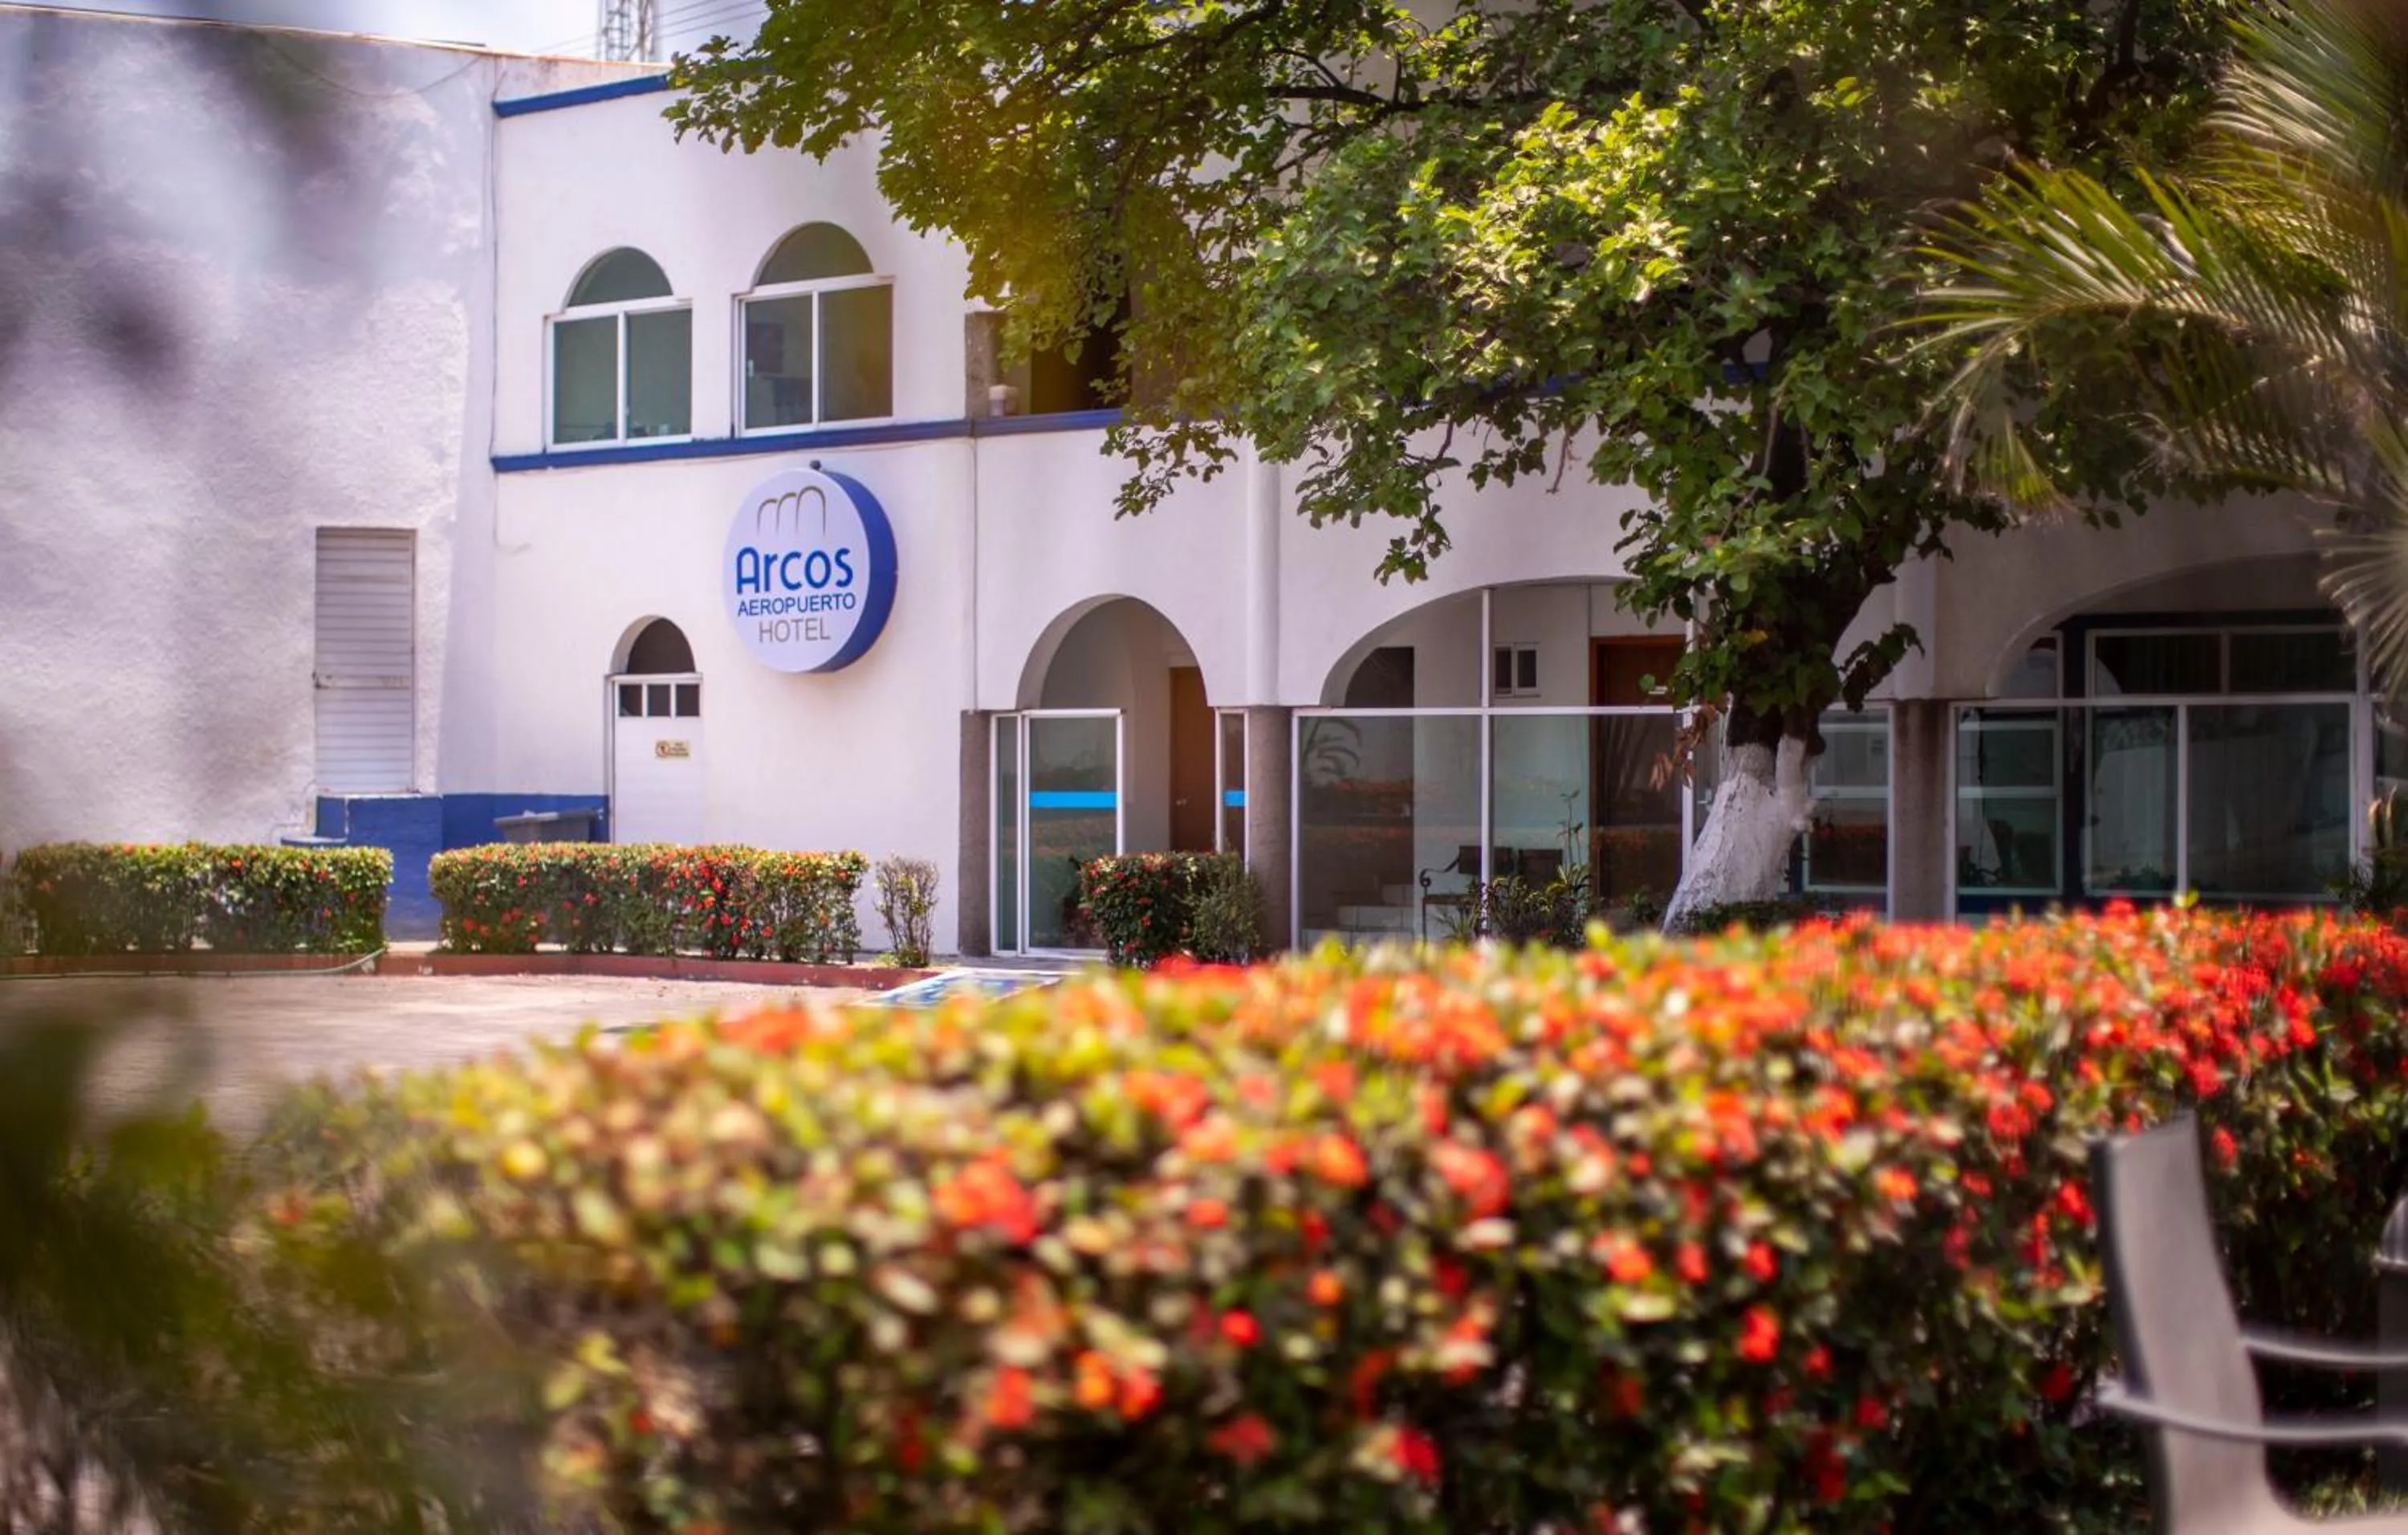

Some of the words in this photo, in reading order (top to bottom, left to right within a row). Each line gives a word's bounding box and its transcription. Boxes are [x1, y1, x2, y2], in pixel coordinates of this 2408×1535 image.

[736, 547, 853, 594] Arcos
[738, 592, 856, 617] AEROPUERTO
[759, 617, 831, 643] HOTEL
